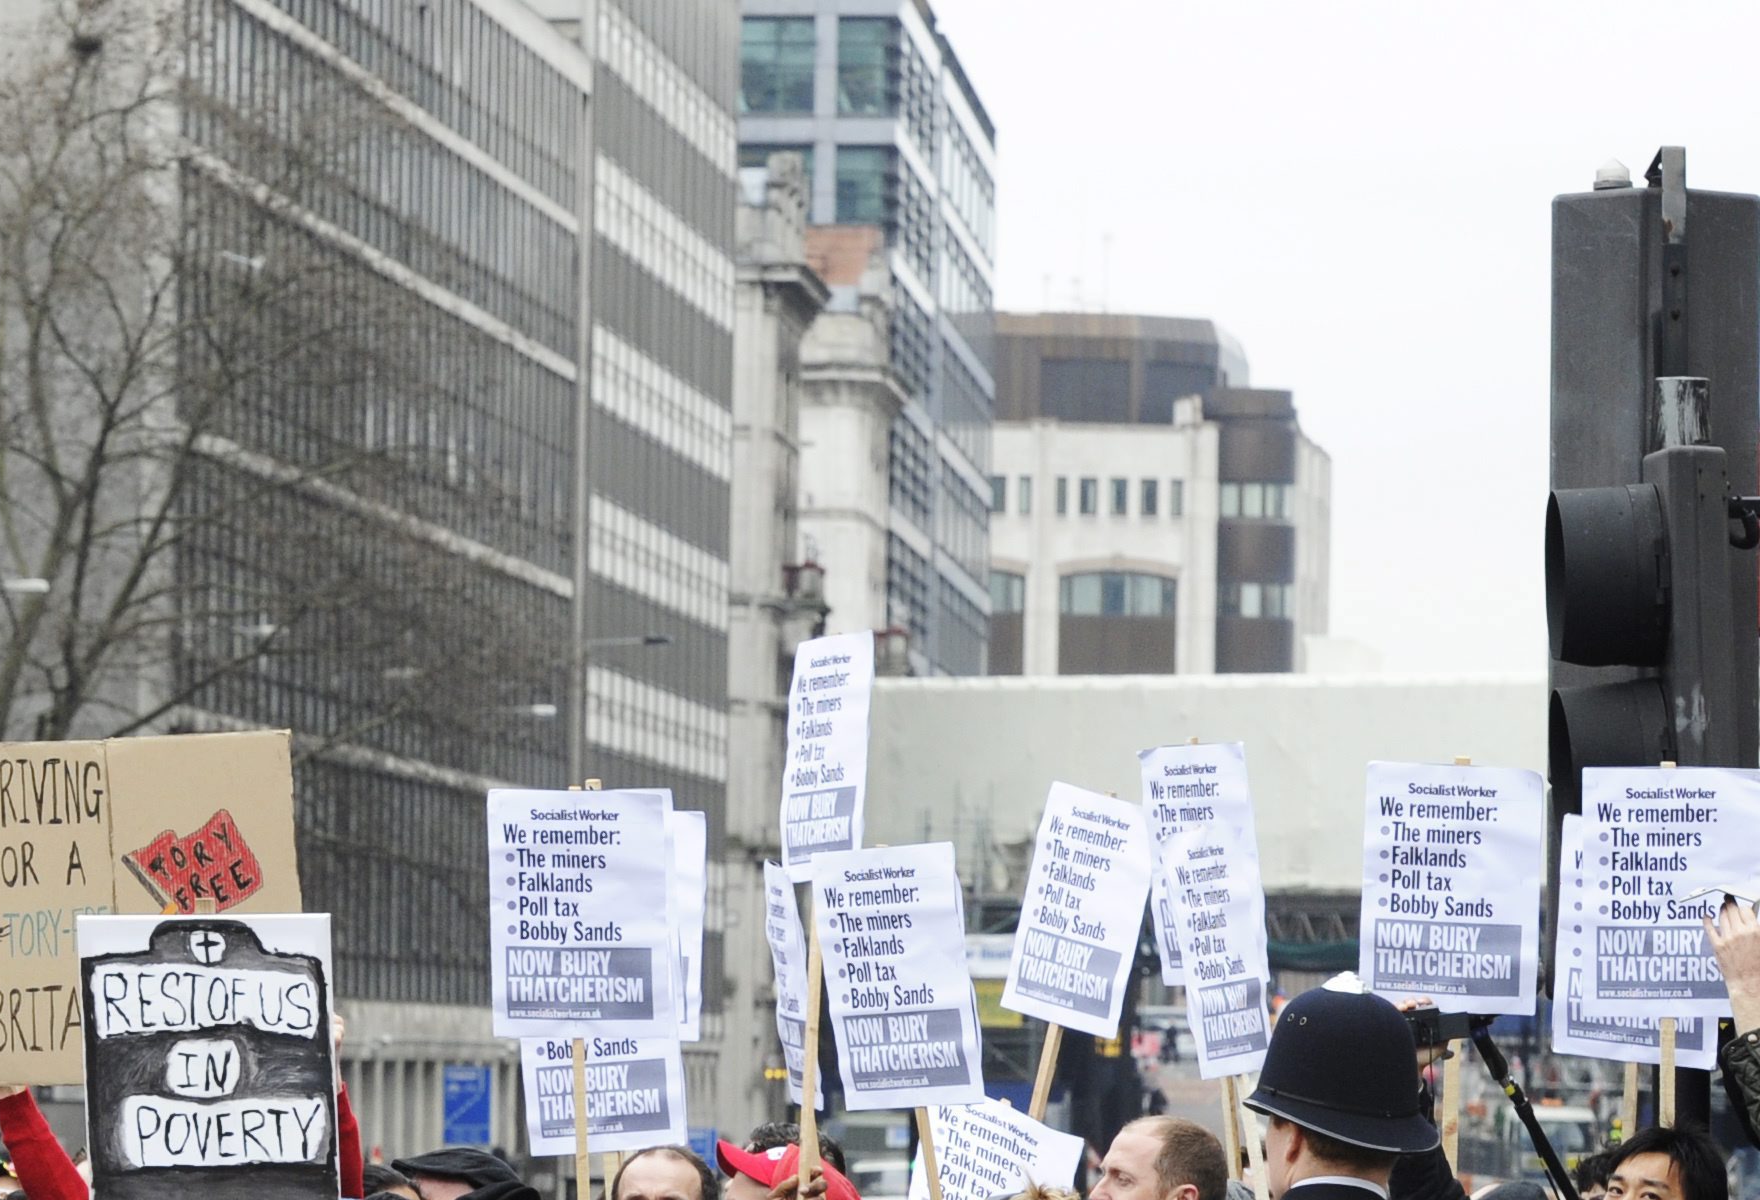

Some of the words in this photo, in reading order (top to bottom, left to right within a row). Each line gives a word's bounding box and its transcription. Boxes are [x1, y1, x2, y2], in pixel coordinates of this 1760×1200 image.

[1150, 780, 1164, 800] We
[1167, 778, 1219, 798] remember:
[1409, 783, 1456, 796] Socialist
[1457, 785, 1497, 798] Worker
[1625, 788, 1674, 799] Socialist
[1675, 788, 1717, 799] Worker
[531, 809, 578, 821] Socialist
[579, 810, 619, 821] Worker
[1159, 804, 1176, 823] The
[1180, 802, 1214, 822] miners
[1380, 797, 1403, 817] We
[1409, 802, 1498, 822] remember:
[1598, 803, 1622, 822] We
[1628, 803, 1718, 823] remember:
[503, 824, 527, 844] We
[533, 825, 621, 845] remember:
[1050, 815, 1064, 835] We
[1066, 825, 1128, 853] remember:
[1392, 822, 1421, 842] The
[1427, 824, 1481, 844] miners
[1611, 827, 1640, 847] The
[1646, 827, 1702, 846] miners
[66, 842, 86, 885] A
[149, 821, 236, 881] TORY
[516, 849, 545, 868] The
[552, 849, 606, 869] miners
[1053, 839, 1070, 860] The
[1072, 847, 1111, 872] miners
[1392, 846, 1467, 868] Falklands
[1612, 852, 1687, 871] Falklands
[175, 859, 254, 911] FREE
[518, 873, 593, 892] Falklands
[844, 869, 883, 882] Socialist
[883, 867, 915, 879] Worker
[1048, 861, 1096, 891] Falklands
[1176, 863, 1190, 886] We
[1391, 869, 1420, 890] Poll
[1427, 871, 1452, 891] tax
[1612, 876, 1640, 895] Poll
[1648, 877, 1673, 895] tax
[519, 896, 547, 916] Poll
[554, 898, 579, 916] tax
[824, 888, 844, 908] We
[849, 883, 919, 907] remember:
[1044, 883, 1064, 904] Poll
[1065, 890, 1081, 910] tax
[1187, 889, 1201, 908] The
[1391, 893, 1439, 919] Bobby
[1445, 896, 1493, 918] Sands
[837, 912, 863, 933] The
[866, 910, 912, 931] miners
[1040, 906, 1070, 934] Bobby
[1072, 915, 1106, 941] Sands
[1192, 908, 1227, 932] Falklands
[1612, 900, 1660, 924] Bobby
[1667, 900, 1716, 920] Sands
[520, 921, 568, 945] Bobby
[574, 921, 622, 941] Sands
[1377, 922, 1423, 948] NOW
[1429, 926, 1481, 952] BURY
[1599, 930, 1646, 955] NOW
[1653, 930, 1704, 955] BURY
[843, 934, 905, 958] Falklands
[1026, 930, 1056, 960] NOW
[1055, 940, 1094, 970] BURY
[1195, 937, 1211, 957] Poll
[1213, 936, 1226, 952] tax
[508, 950, 553, 976] NOW
[561, 951, 611, 976] BURY
[847, 962, 871, 983] Poll
[875, 962, 897, 981] tax
[1199, 961, 1225, 981] Bobby
[1376, 949, 1511, 979] THATCHERISM
[1599, 957, 1723, 982] THATCHERIS
[508, 977, 644, 1003] THATCHERISM
[1020, 956, 1108, 1002] THATCHERISM
[259, 982, 313, 1030] US
[851, 986, 889, 1011] Bobby
[894, 983, 934, 1006] Sands
[1199, 988, 1226, 1016] NOW
[846, 1017, 884, 1045] NOW
[888, 1014, 928, 1042] BURY
[593, 1038, 638, 1057] Sands
[850, 1041, 960, 1073] THATCHERISM
[177, 1049, 233, 1092] IN
[585, 1065, 629, 1091] BURY
[137, 1103, 320, 1165] POVERTY
[939, 1105, 958, 1126] We
[963, 1120, 1037, 1167] remember:
[947, 1128, 971, 1151] The
[976, 1145, 1022, 1177] miners
[940, 1164, 966, 1189] Poll
[945, 1146, 1007, 1189] Falklands
